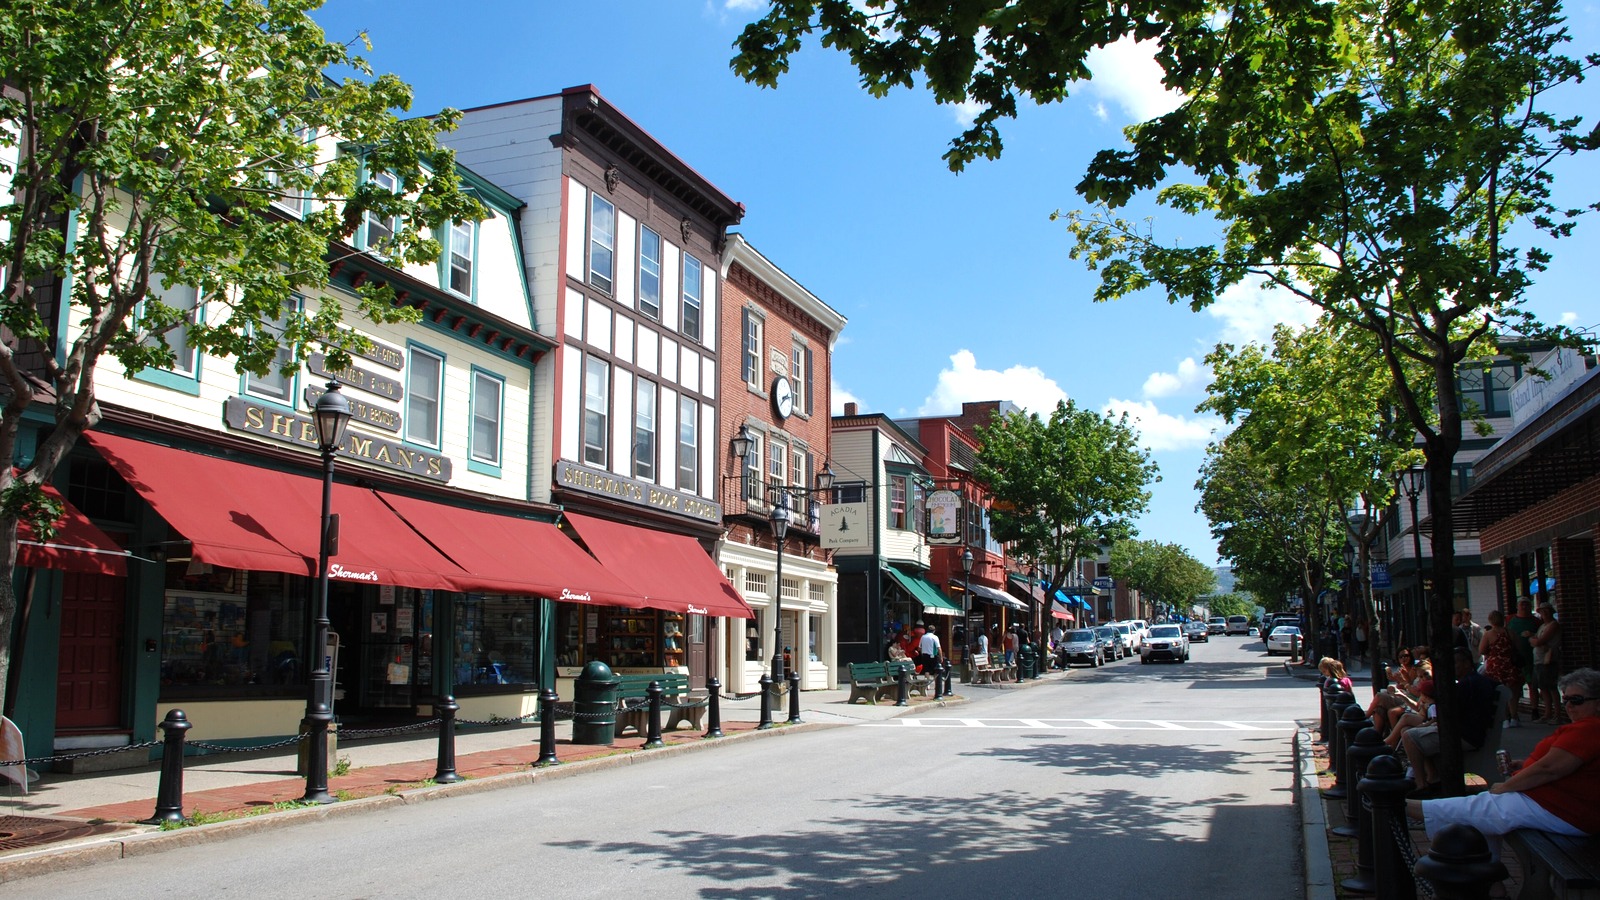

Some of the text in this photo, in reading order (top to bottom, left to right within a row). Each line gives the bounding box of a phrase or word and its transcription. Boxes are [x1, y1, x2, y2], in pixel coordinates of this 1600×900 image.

[1512, 379, 1531, 412] Island
[1531, 365, 1559, 401] Impts
[358, 404, 367, 418] TO
[244, 406, 442, 476] SHEMAN'S
[564, 467, 717, 519] SHERMAN'S BOOK STORE
[830, 507, 857, 516] ACADIA
[328, 564, 378, 581] Sherman's
[559, 588, 591, 601] Sherman's
[687, 604, 708, 615] Sherman's
